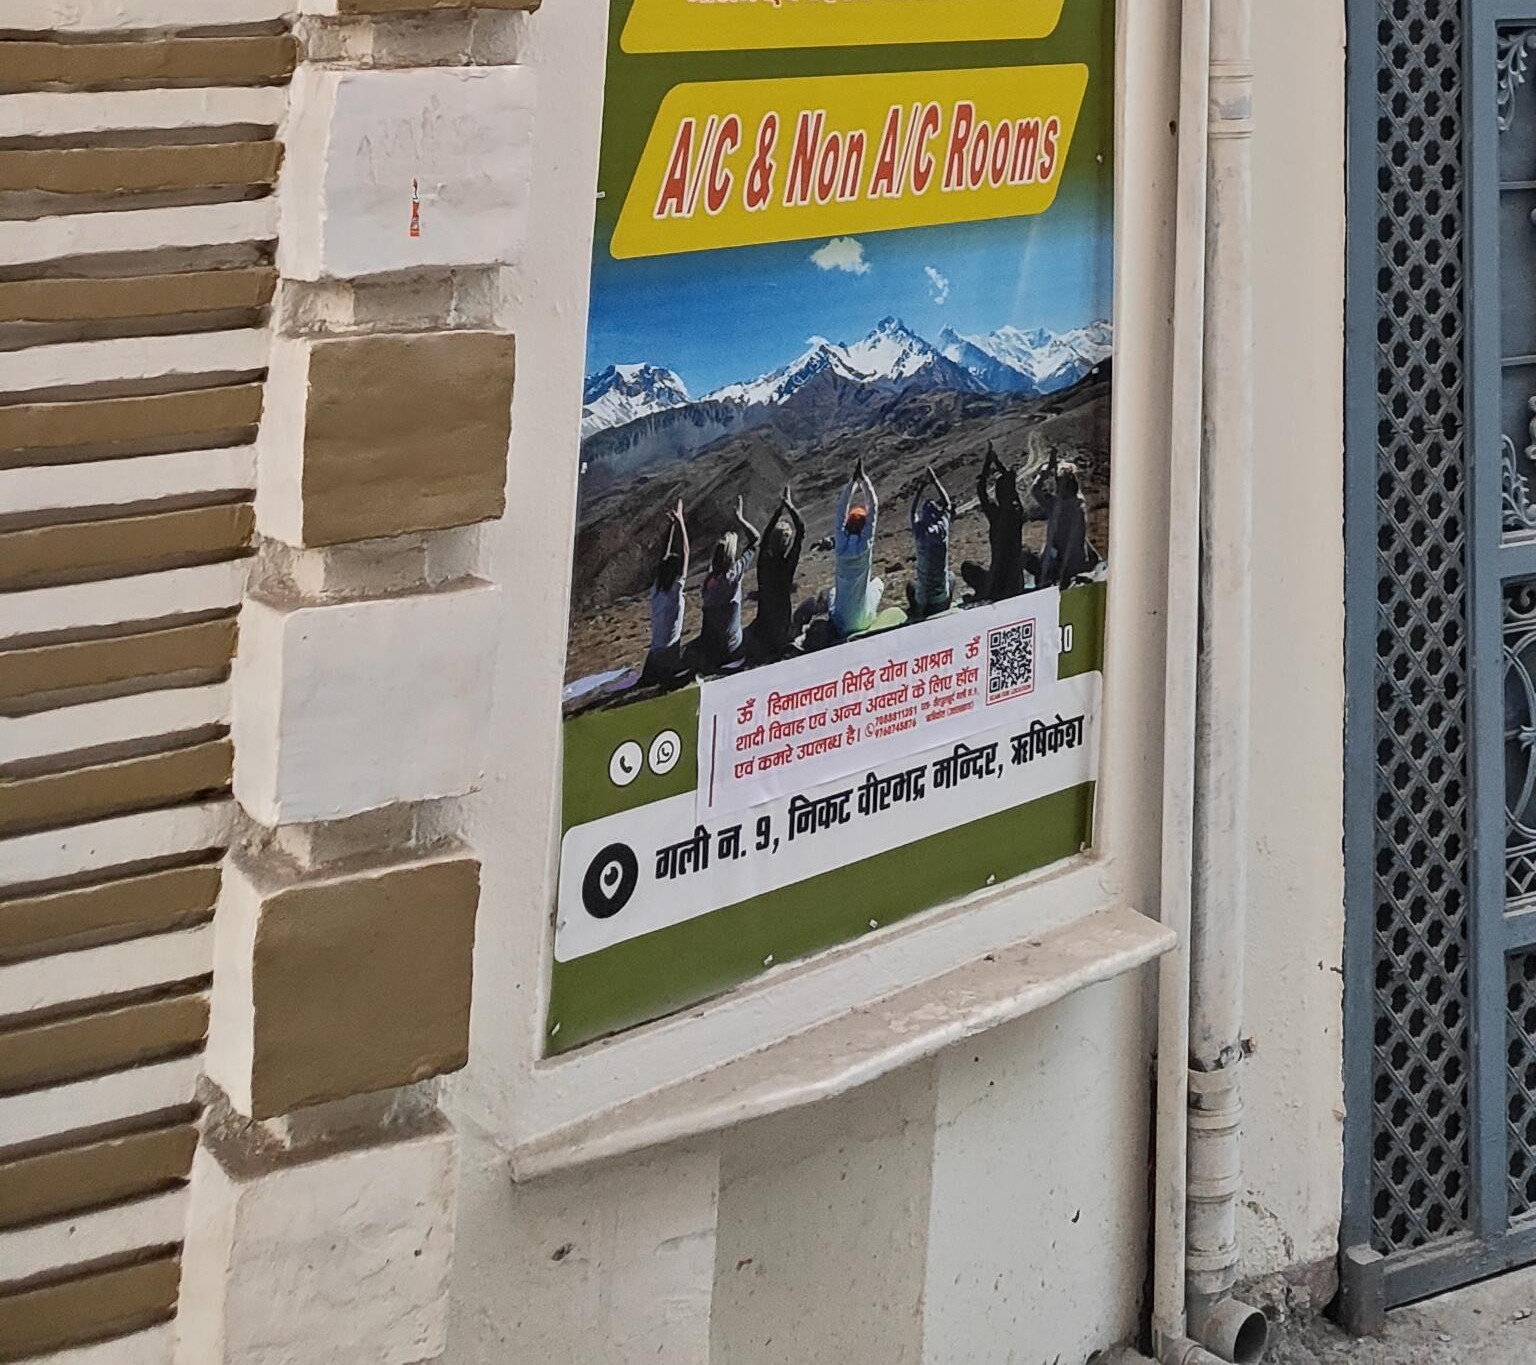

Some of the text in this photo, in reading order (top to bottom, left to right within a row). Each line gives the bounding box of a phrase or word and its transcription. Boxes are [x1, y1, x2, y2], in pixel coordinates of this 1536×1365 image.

[655, 101, 1060, 217] A/C & Non A/C Rooms
[736, 725, 766, 751] शादी
[769, 721, 807, 742] विवाह
[809, 709, 828, 730] एवं
[831, 702, 863, 723] अन्य
[866, 684, 909, 713] अवसरों
[911, 679, 925, 698] के
[928, 674, 953, 695] लिए
[768, 681, 839, 717] हिमालयन
[842, 666, 876, 694] सिद्धि
[879, 659, 909, 683] योग
[911, 648, 954, 675] आश्रम
[734, 755, 756, 779] एवं
[758, 743, 794, 770] कमरे
[796, 733, 843, 760] उपलब्ध
[655, 825, 712, 880] गली
[716, 823, 747, 860] न.
[788, 794, 854, 842] निकट
[857, 771, 928, 816] वीरभद्र
[1009, 713, 1085, 766] ऋषिकेश
